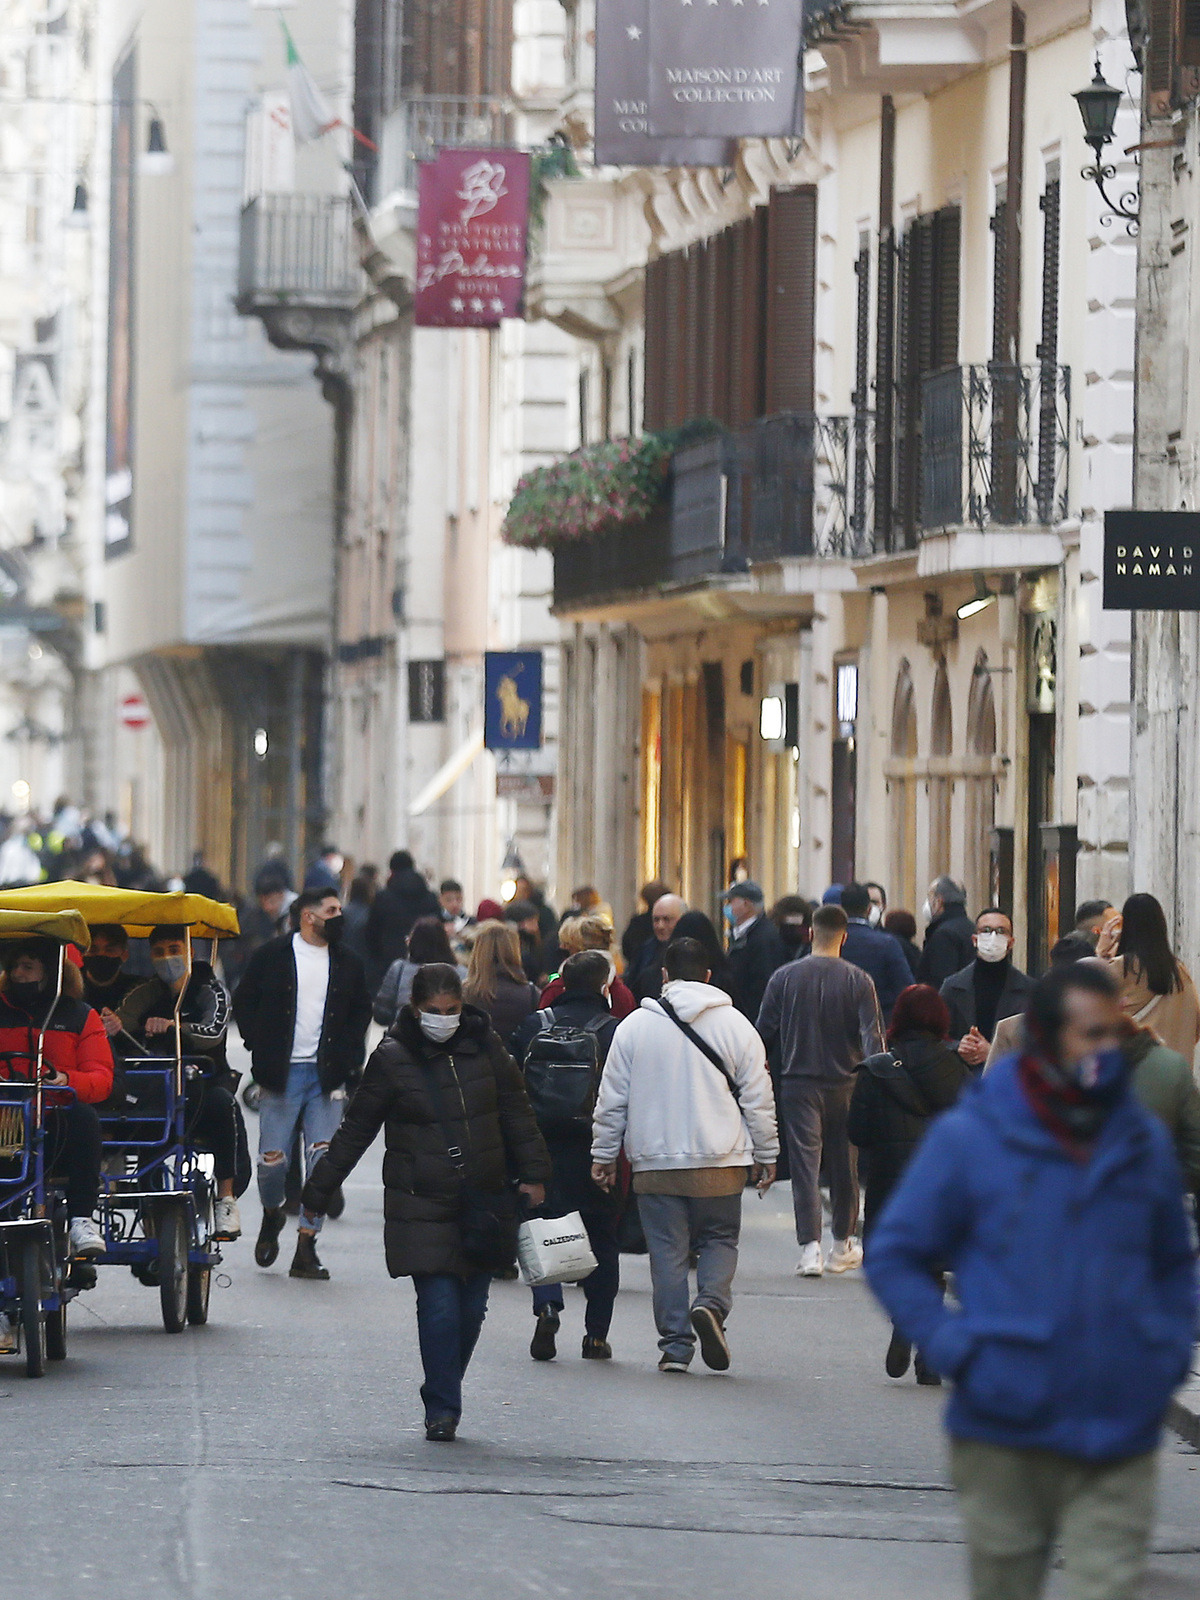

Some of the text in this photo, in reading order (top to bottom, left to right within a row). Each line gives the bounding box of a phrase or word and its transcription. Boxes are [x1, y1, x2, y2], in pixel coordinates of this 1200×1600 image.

[666, 67, 784, 83] MAISON D'ART
[672, 86, 776, 103] COLLECTION
[1117, 545, 1193, 558] DAVID
[1117, 563, 1192, 576] NAMAN
